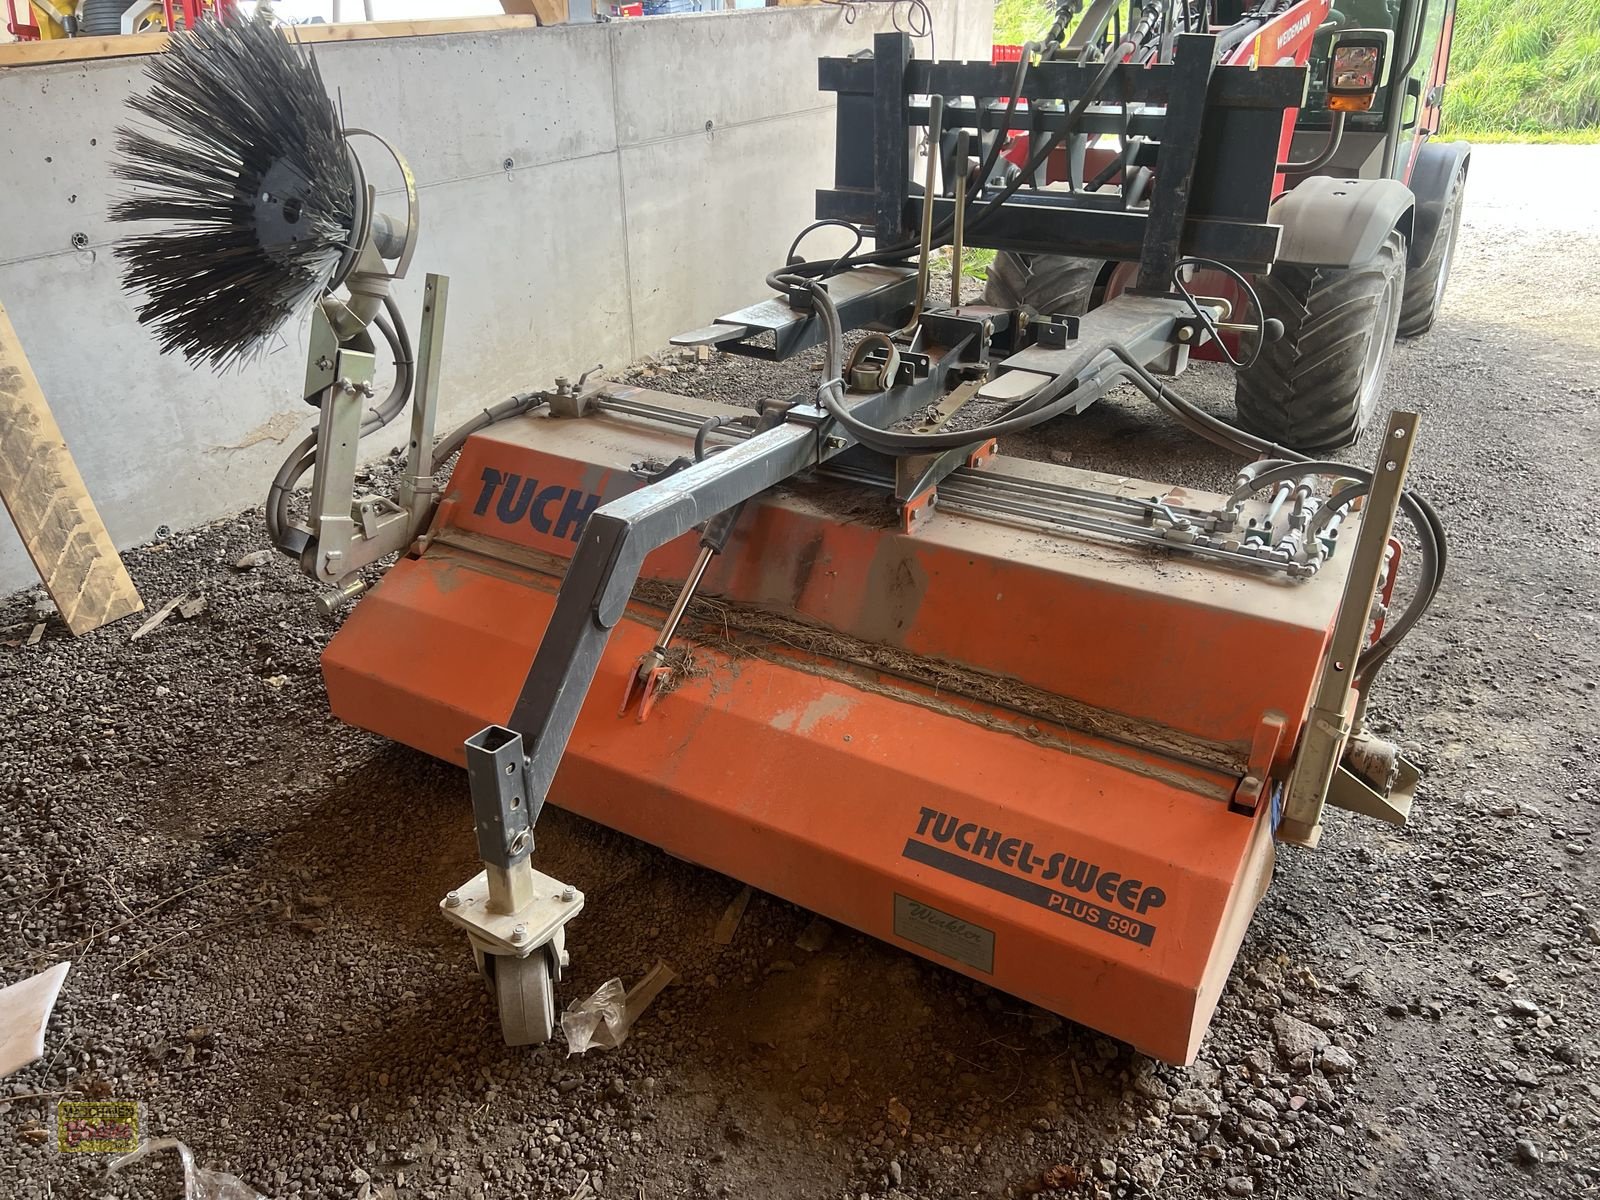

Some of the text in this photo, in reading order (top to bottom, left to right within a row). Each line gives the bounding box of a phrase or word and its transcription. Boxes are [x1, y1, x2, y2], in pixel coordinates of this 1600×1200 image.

[1277, 11, 1311, 50] WEIDEMANN
[473, 467, 602, 542] TUCH
[916, 806, 1166, 915] TUCHEL-SWEEP
[1048, 893, 1140, 938] PLUS 590
